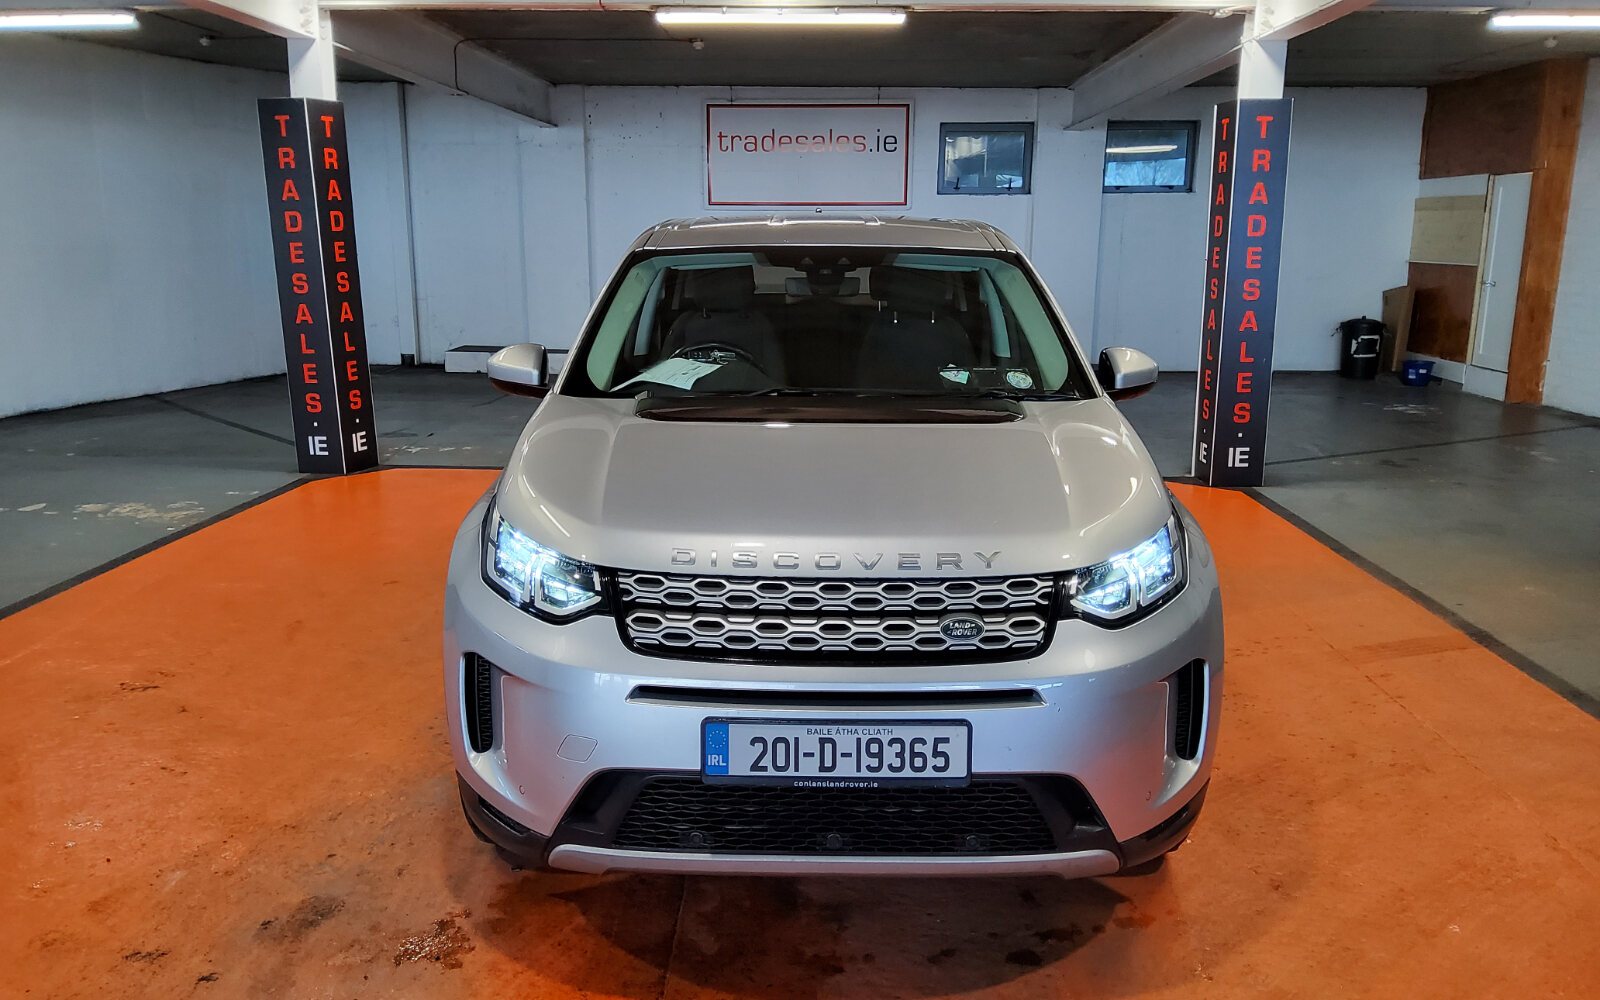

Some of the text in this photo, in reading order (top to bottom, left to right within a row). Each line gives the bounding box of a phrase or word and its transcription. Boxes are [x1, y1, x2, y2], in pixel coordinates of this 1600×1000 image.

[717, 128, 898, 153] tradesales.ie
[671, 547, 1002, 571] DISCOVERY
[806, 726, 893, 736] BAILE ÁTHA CLIATH
[707, 754, 727, 766] IRL
[749, 736, 951, 773] 201-D-19365
[793, 780, 879, 788] conlanslandrover.ie
